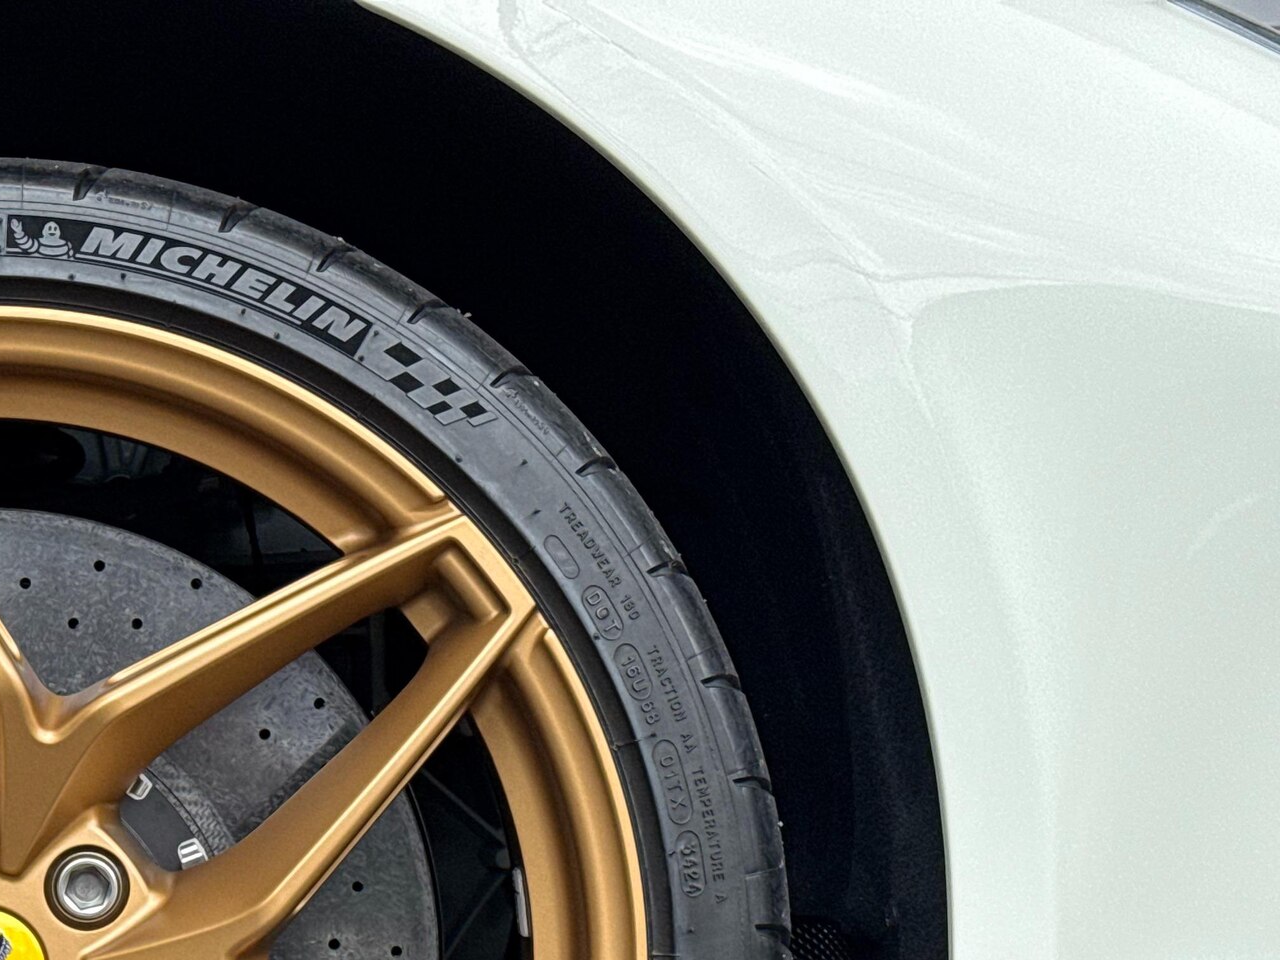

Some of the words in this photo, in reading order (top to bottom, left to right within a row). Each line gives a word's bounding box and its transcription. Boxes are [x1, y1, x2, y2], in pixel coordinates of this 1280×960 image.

[80, 226, 368, 343] MICHELIN
[556, 500, 623, 591] TREADWEAR
[644, 643, 688, 724] TRACTION
[584, 589, 621, 637] DOT
